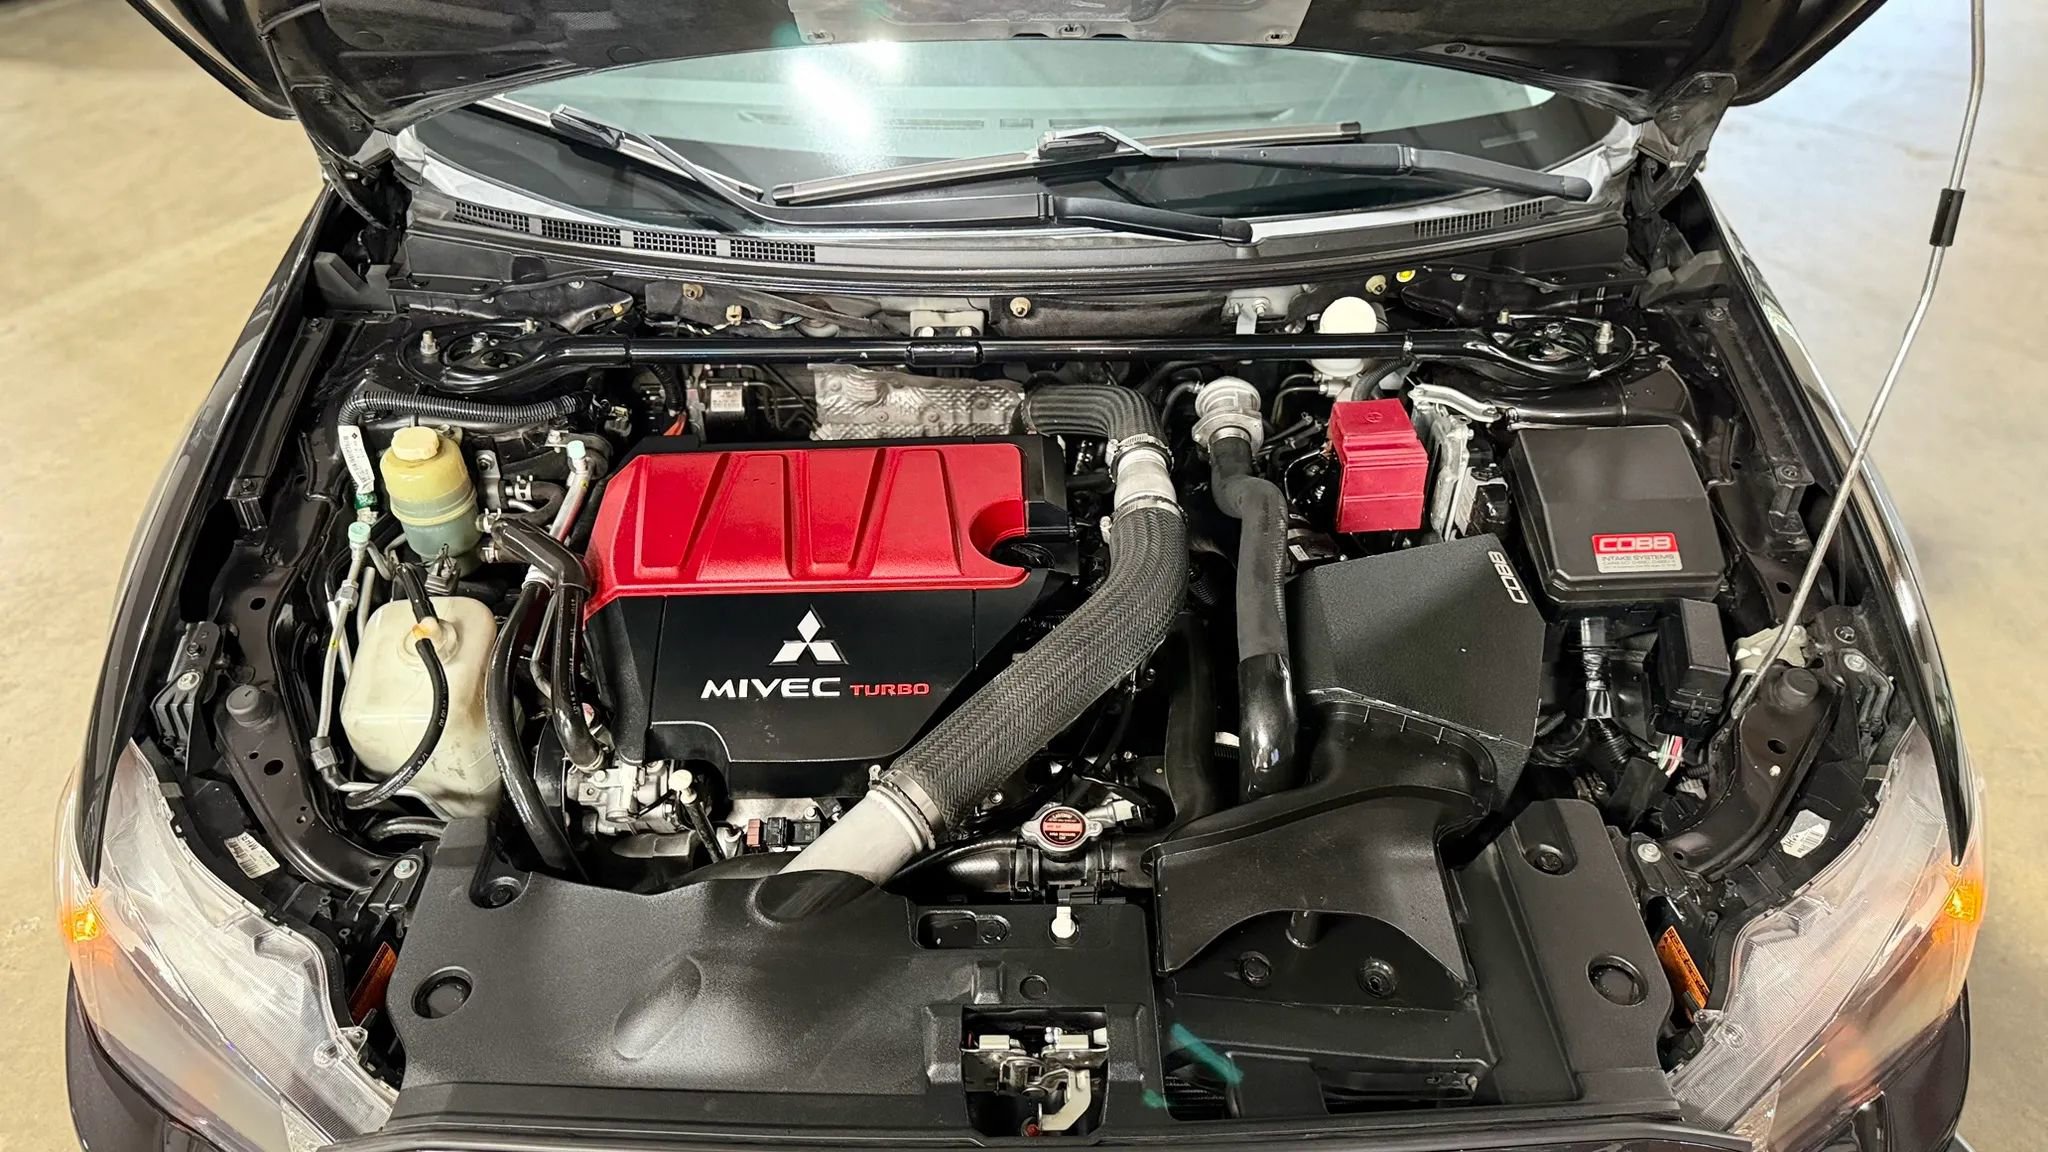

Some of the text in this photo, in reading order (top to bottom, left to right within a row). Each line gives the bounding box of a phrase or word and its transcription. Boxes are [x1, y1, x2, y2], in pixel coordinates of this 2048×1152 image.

[1599, 536, 1671, 552] COBB
[1632, 553, 1675, 561] SYSTEMS
[1488, 551, 1528, 604] COBB
[700, 676, 932, 700] MIVEC TURBO
